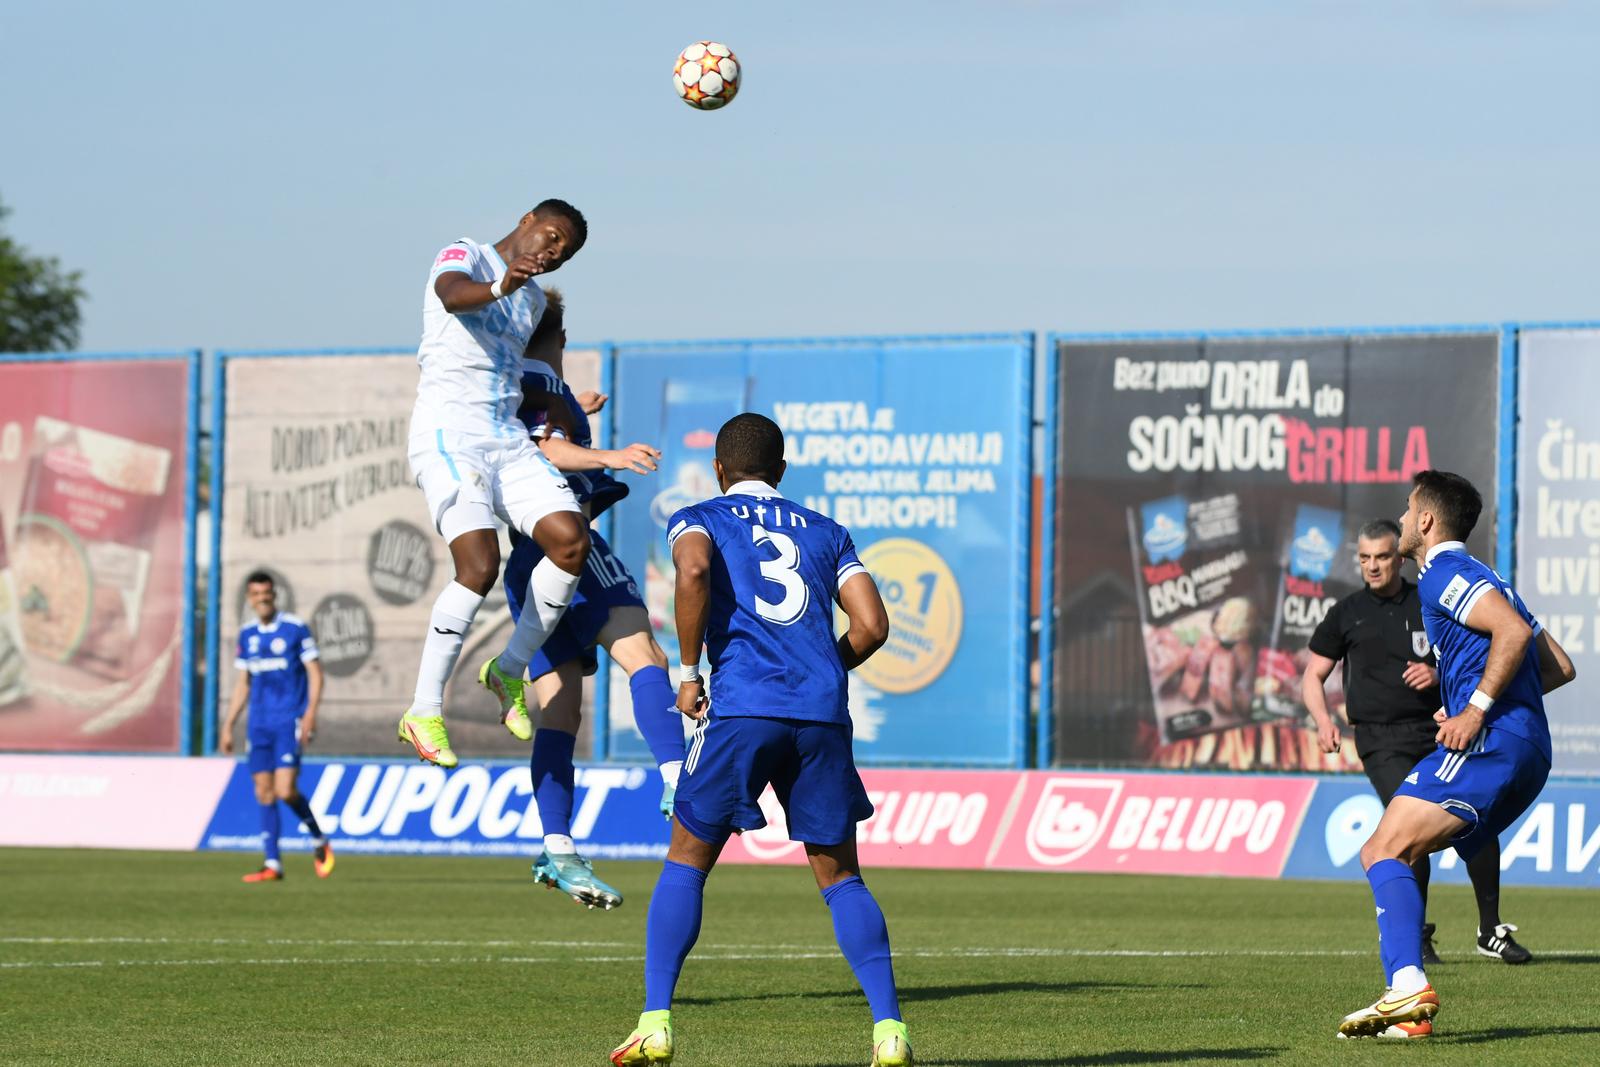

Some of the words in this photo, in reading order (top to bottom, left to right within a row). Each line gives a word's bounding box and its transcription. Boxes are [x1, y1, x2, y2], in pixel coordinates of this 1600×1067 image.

[1113, 357, 1155, 390] Bez
[1156, 360, 1211, 393] puno
[1210, 359, 1311, 411] DRILA
[1313, 384, 1345, 417] do
[773, 401, 869, 432] VEGETA
[872, 408, 895, 431] JE
[271, 424, 330, 474] DOBRO
[782, 432, 1004, 466] AJPRODAVANIJI
[1127, 402, 1286, 472] SOČNOG
[1280, 415, 1430, 484] GRILLA
[752, 524, 810, 627] 3
[915, 570, 938, 615] 1
[1148, 575, 1198, 618] BBQ
[1443, 587, 1460, 607] PAN
[855, 790, 989, 846] ELUPO
[1108, 796, 1286, 855] BELUPO
